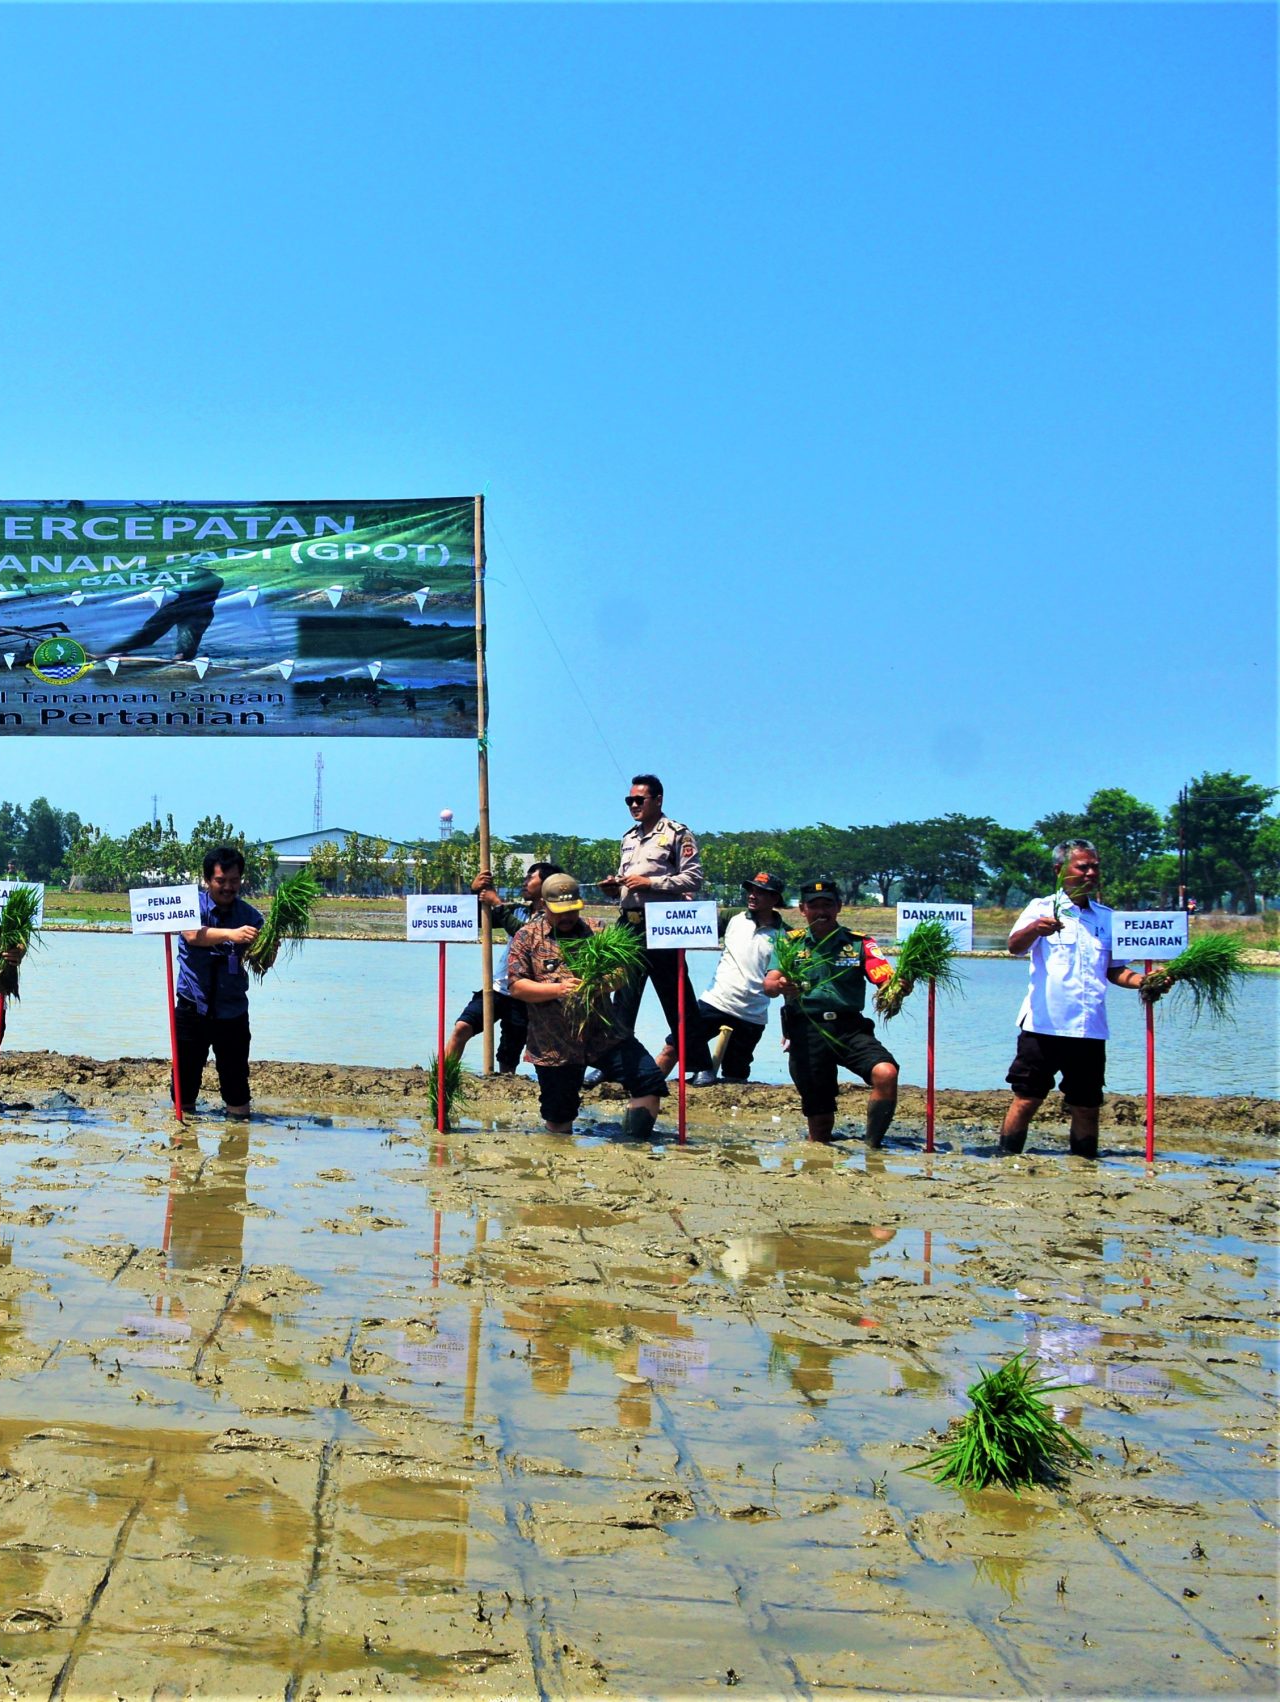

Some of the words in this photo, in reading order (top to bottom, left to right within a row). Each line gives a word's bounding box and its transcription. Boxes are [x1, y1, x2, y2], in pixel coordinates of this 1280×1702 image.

[290, 542, 451, 567] (GPOT)
[16, 691, 160, 704] Tanaman
[169, 691, 285, 706] Pangan
[40, 707, 267, 726] Pertanian
[148, 896, 182, 907] PENJAB
[426, 905, 458, 914] PENJAB
[665, 909, 698, 920] CAMAT
[902, 909, 967, 921] DANRAMIL
[136, 912, 166, 923] UPSUS
[167, 909, 196, 921] JABAR
[412, 919, 439, 928] UPSUS
[440, 919, 473, 929] SUBANG
[1124, 920, 1174, 930] PEJABAT
[652, 926, 713, 936] PUSAKAJAYA
[1117, 936, 1182, 947] PENGAIRAN
